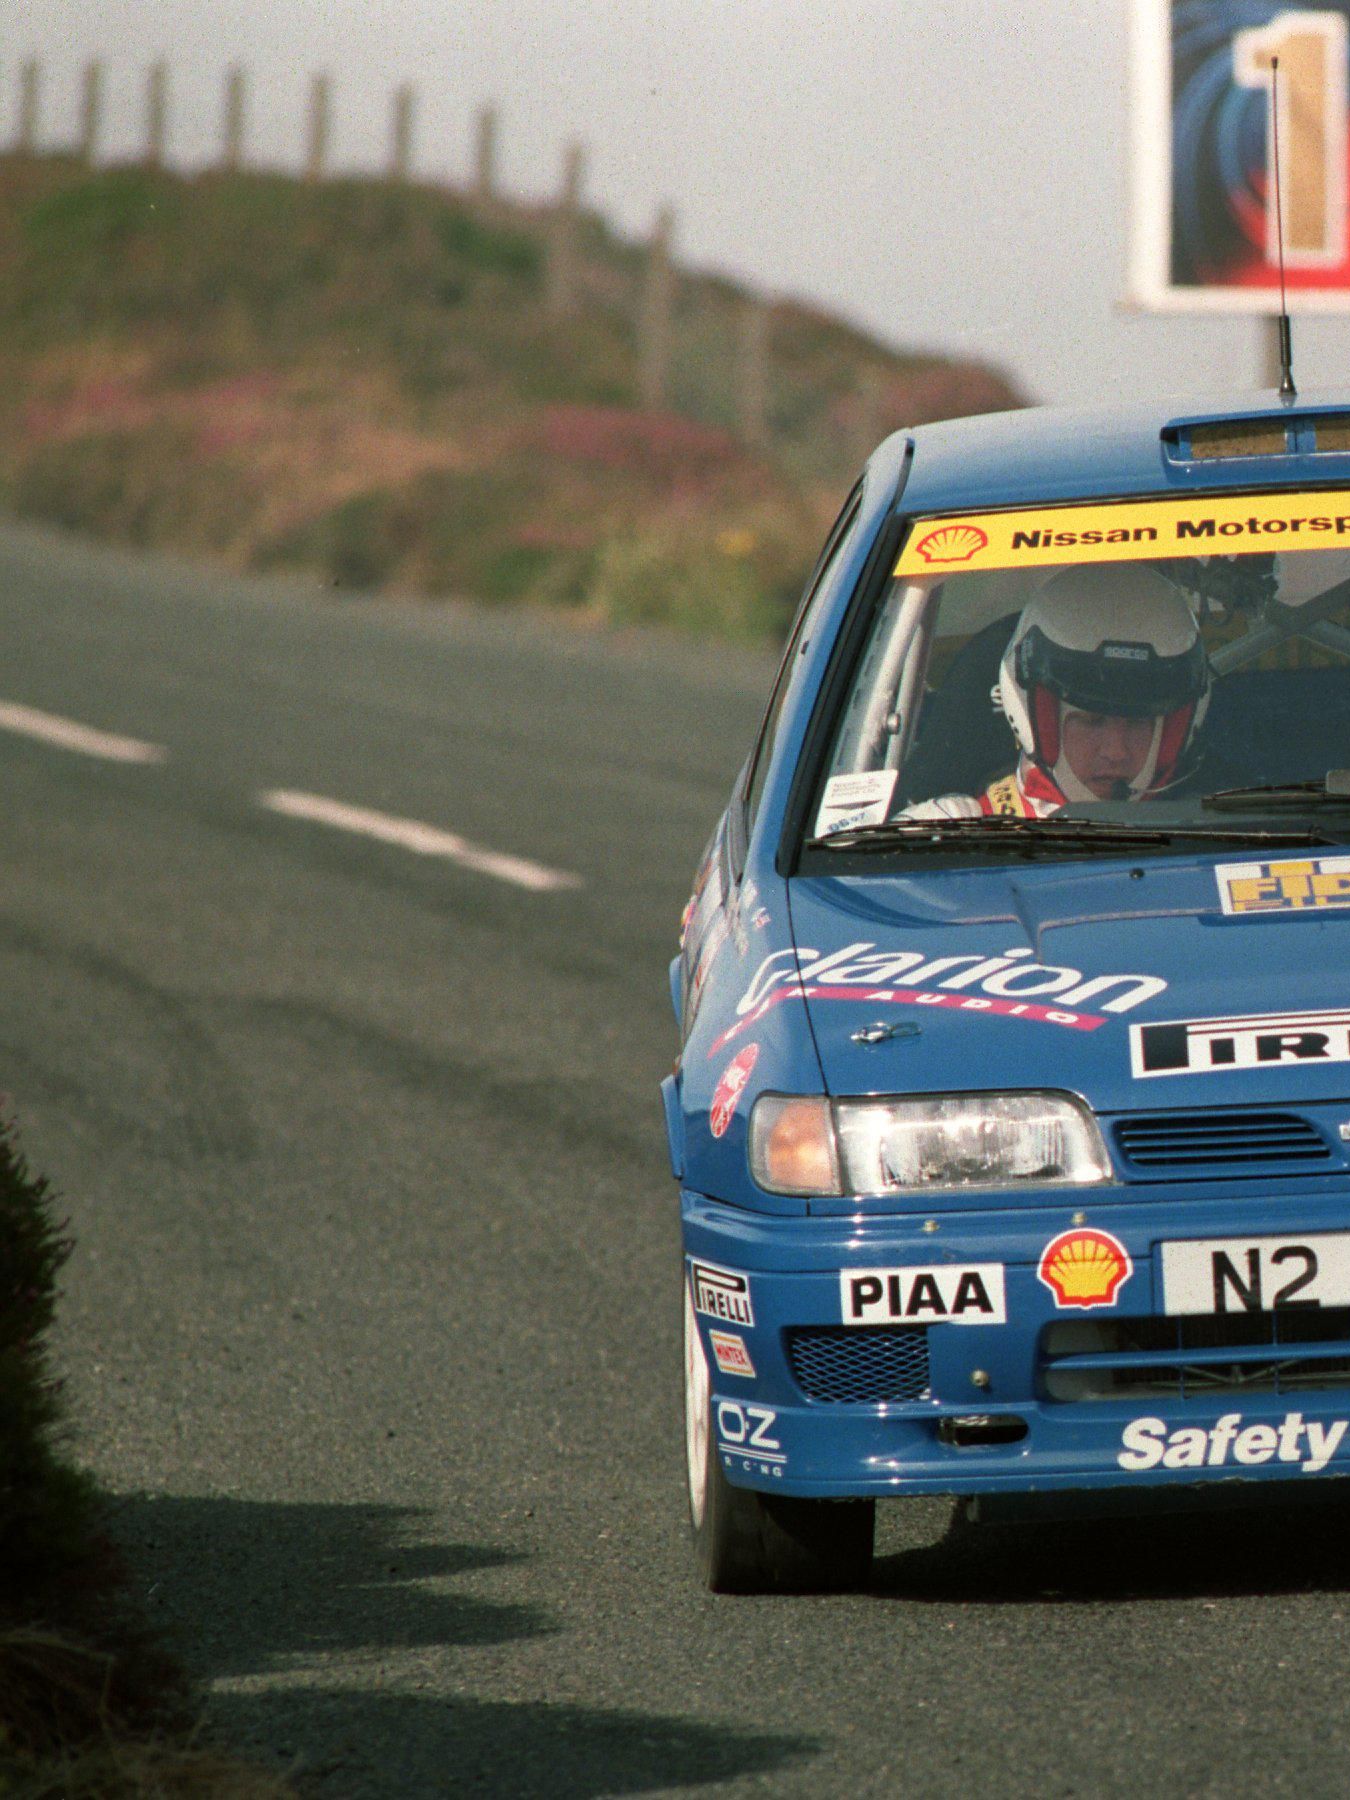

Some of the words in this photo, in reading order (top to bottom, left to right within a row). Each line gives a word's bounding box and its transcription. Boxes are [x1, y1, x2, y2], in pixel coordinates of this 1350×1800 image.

[1010, 525, 1158, 550] Nissan
[866, 990, 1080, 1024] AUDIO
[692, 1262, 751, 1324] PIRELLI
[849, 1271, 995, 1318] PIAA
[1211, 1244, 1321, 1312] N2
[1116, 1412, 1349, 1471] Safety
[724, 1455, 783, 1478] RCNG
